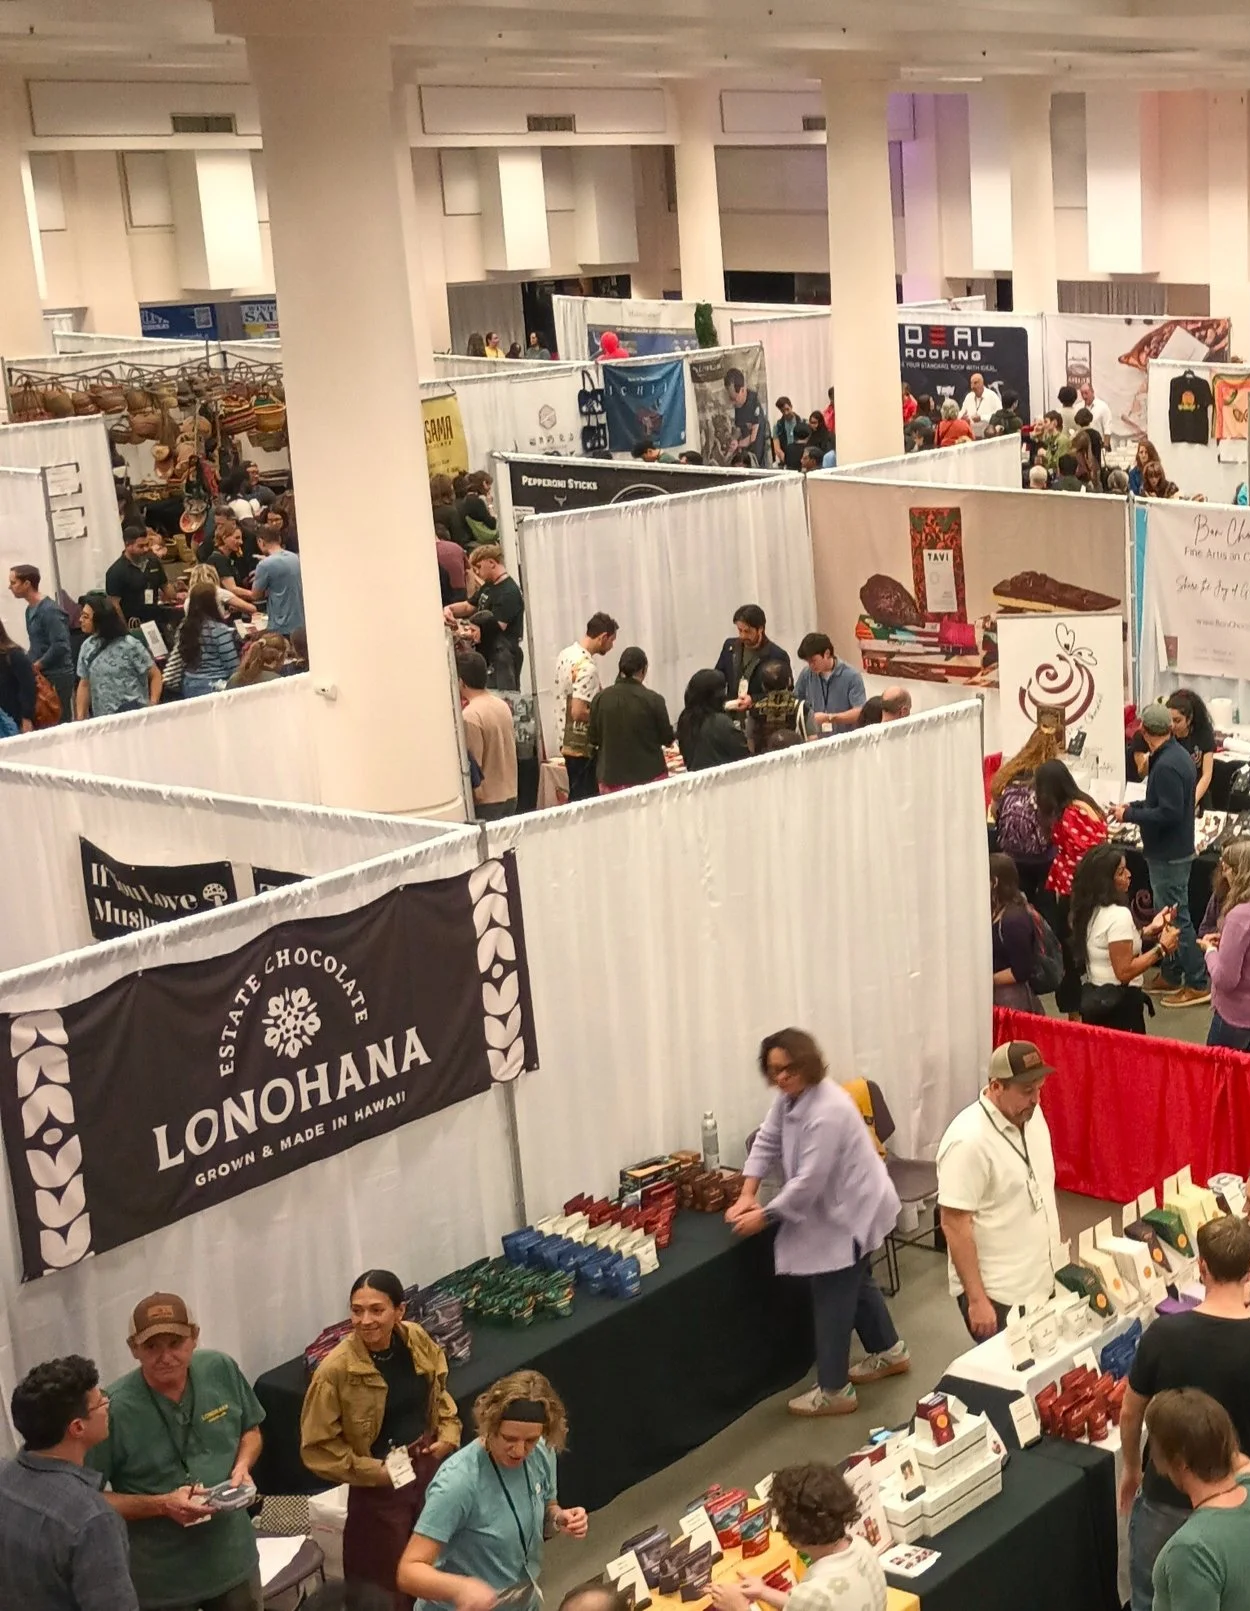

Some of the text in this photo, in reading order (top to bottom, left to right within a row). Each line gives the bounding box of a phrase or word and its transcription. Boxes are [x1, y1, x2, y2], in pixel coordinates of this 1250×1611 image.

[905, 348, 982, 361] ROOFING
[424, 416, 453, 444] SAMA
[1194, 513, 1223, 546] Bon
[927, 552, 950, 562] TAVI
[1184, 547, 1203, 558] Fine
[1176, 575, 1199, 593] Share
[1213, 578, 1229, 603] Joy
[91, 862, 109, 888] If
[219, 947, 368, 1077] ESTATE CHOCOLATE
[152, 1026, 432, 1172] LONOHANA
[195, 1090, 406, 1186] GROWN & MADE IN HAWAII
